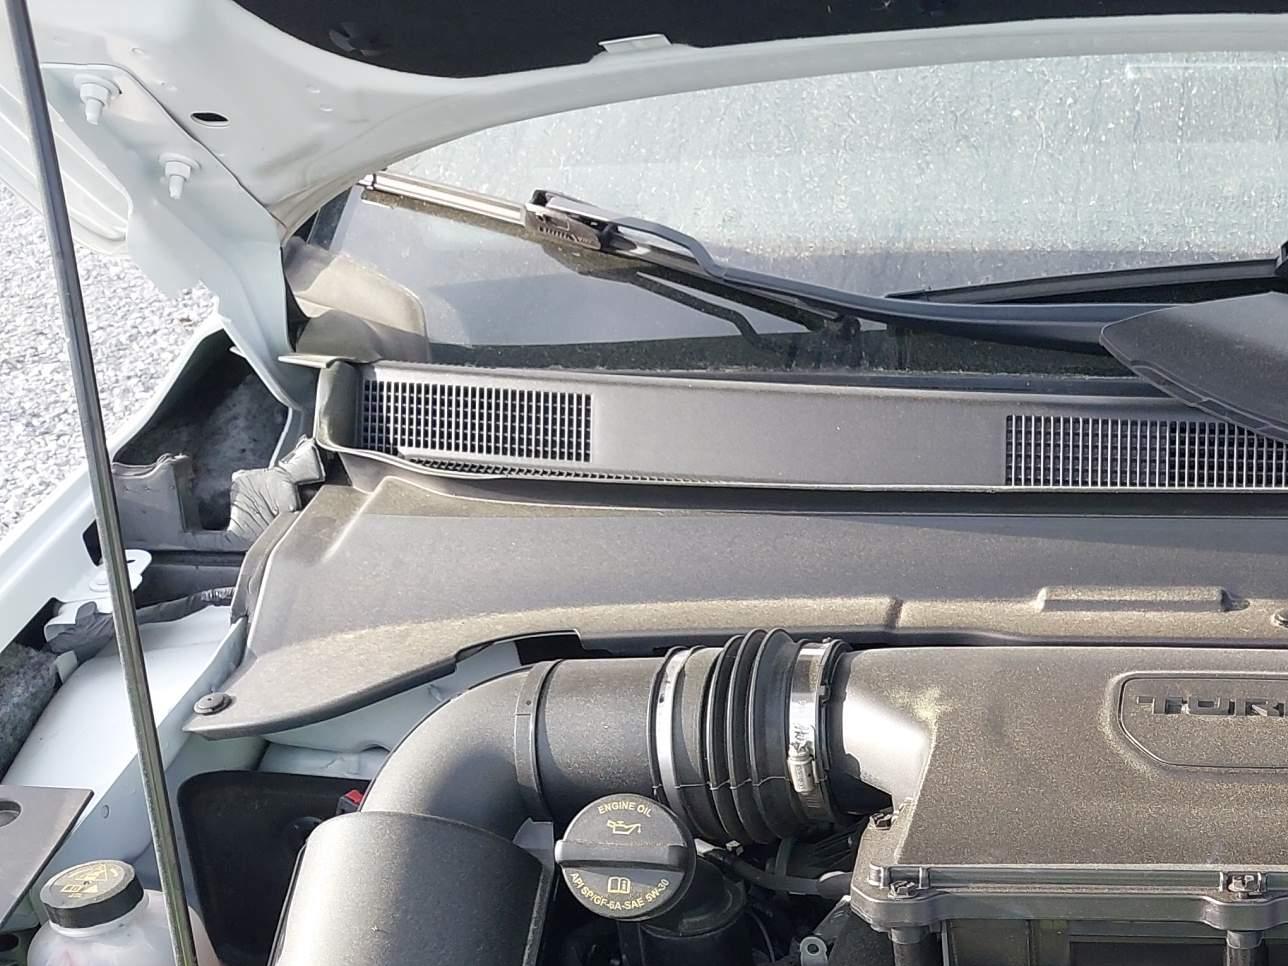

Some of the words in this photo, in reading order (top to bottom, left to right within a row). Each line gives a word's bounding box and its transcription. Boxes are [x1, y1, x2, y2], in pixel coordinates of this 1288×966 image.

[598, 801, 636, 815] ENGINE
[636, 803, 652, 817] OIL
[570, 872, 583, 890] API
[645, 878, 669, 902] 5W-30
